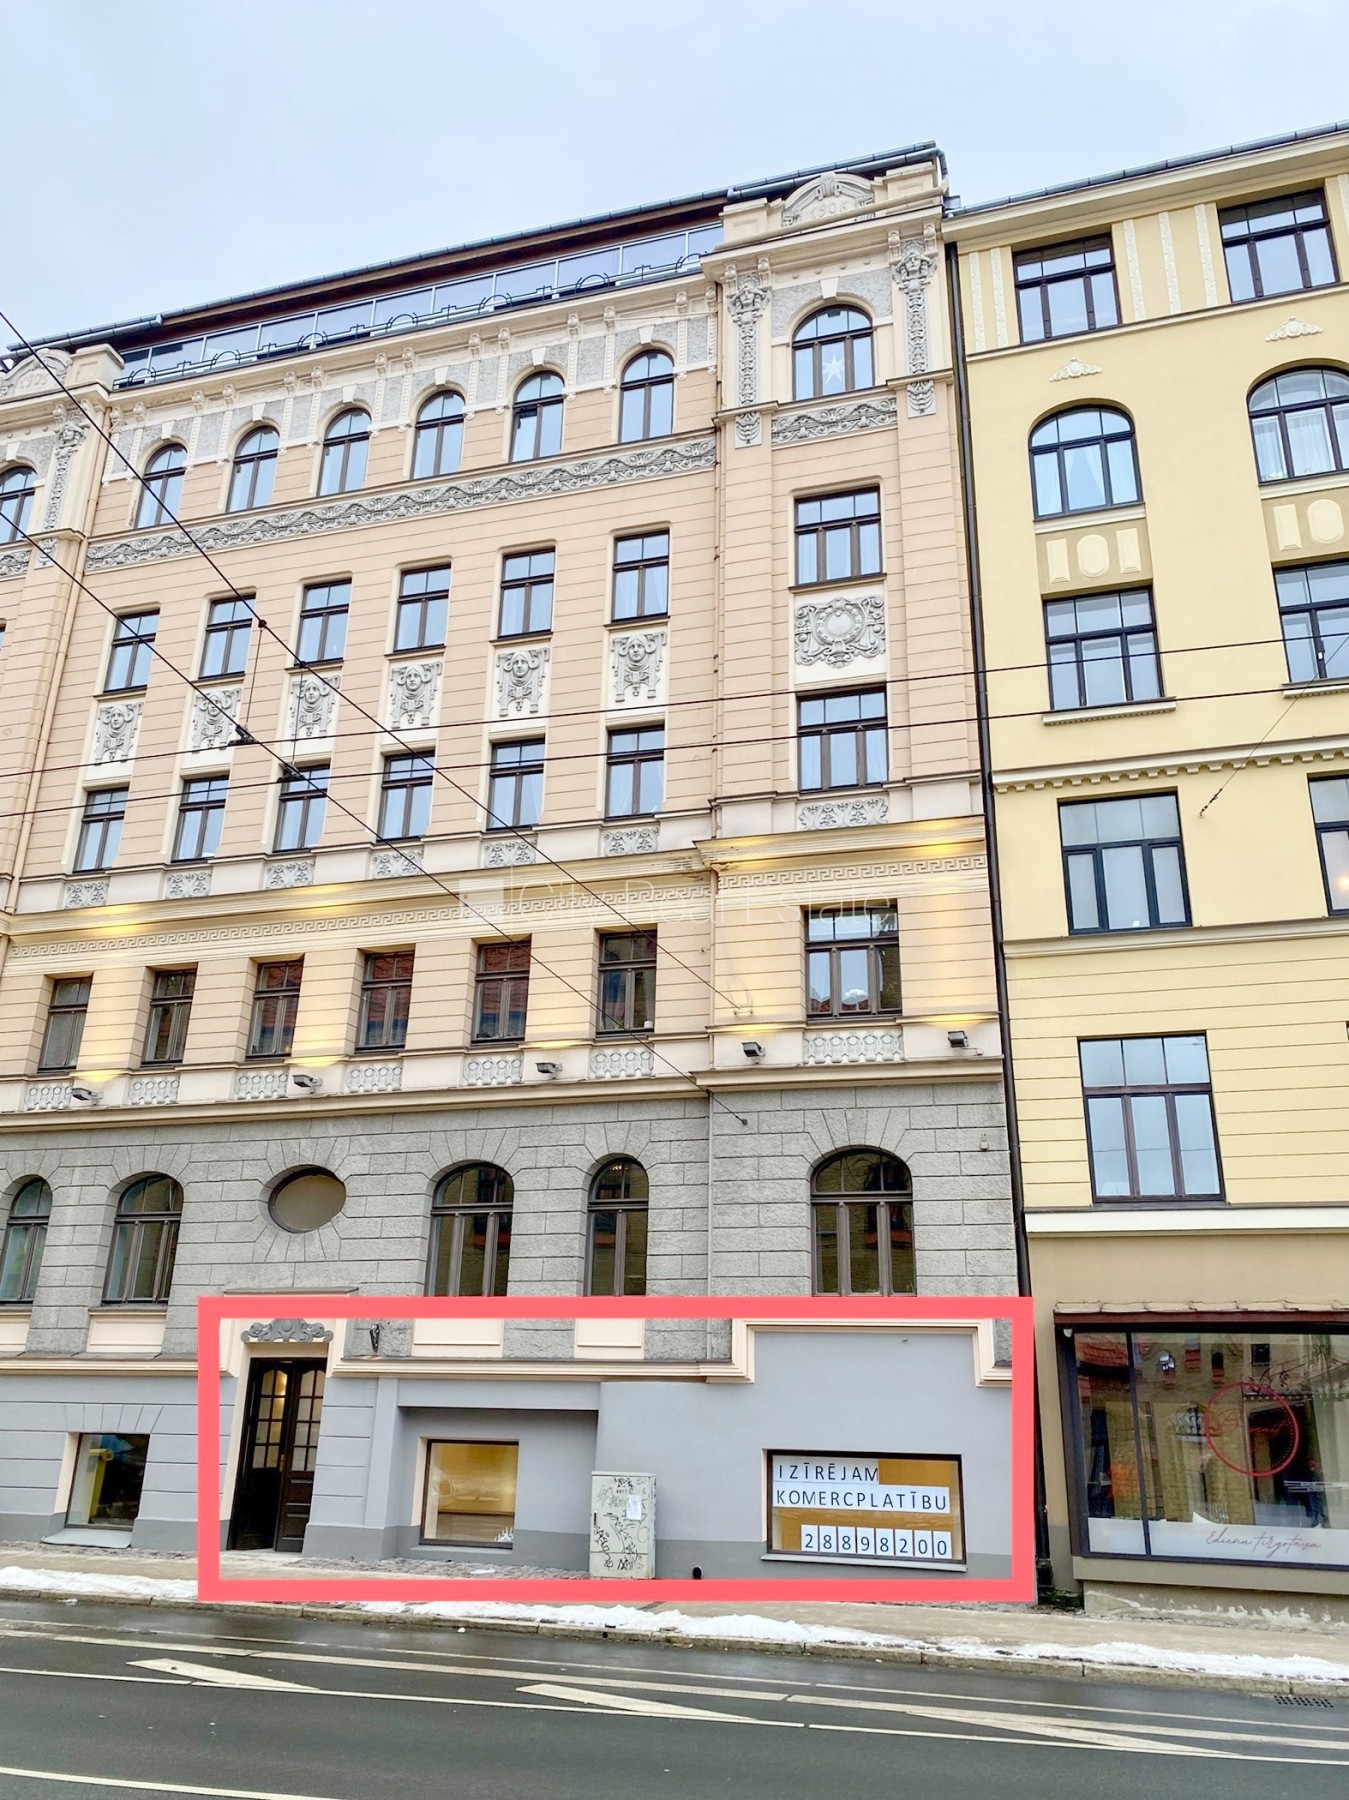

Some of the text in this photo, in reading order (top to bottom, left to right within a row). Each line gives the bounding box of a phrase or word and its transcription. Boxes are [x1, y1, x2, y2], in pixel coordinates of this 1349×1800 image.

[778, 1462, 878, 1482] IZĪRĒJAM
[776, 1489, 947, 1510] KOMERCPLATĪBU
[804, 1533, 947, 1555] 28898200
